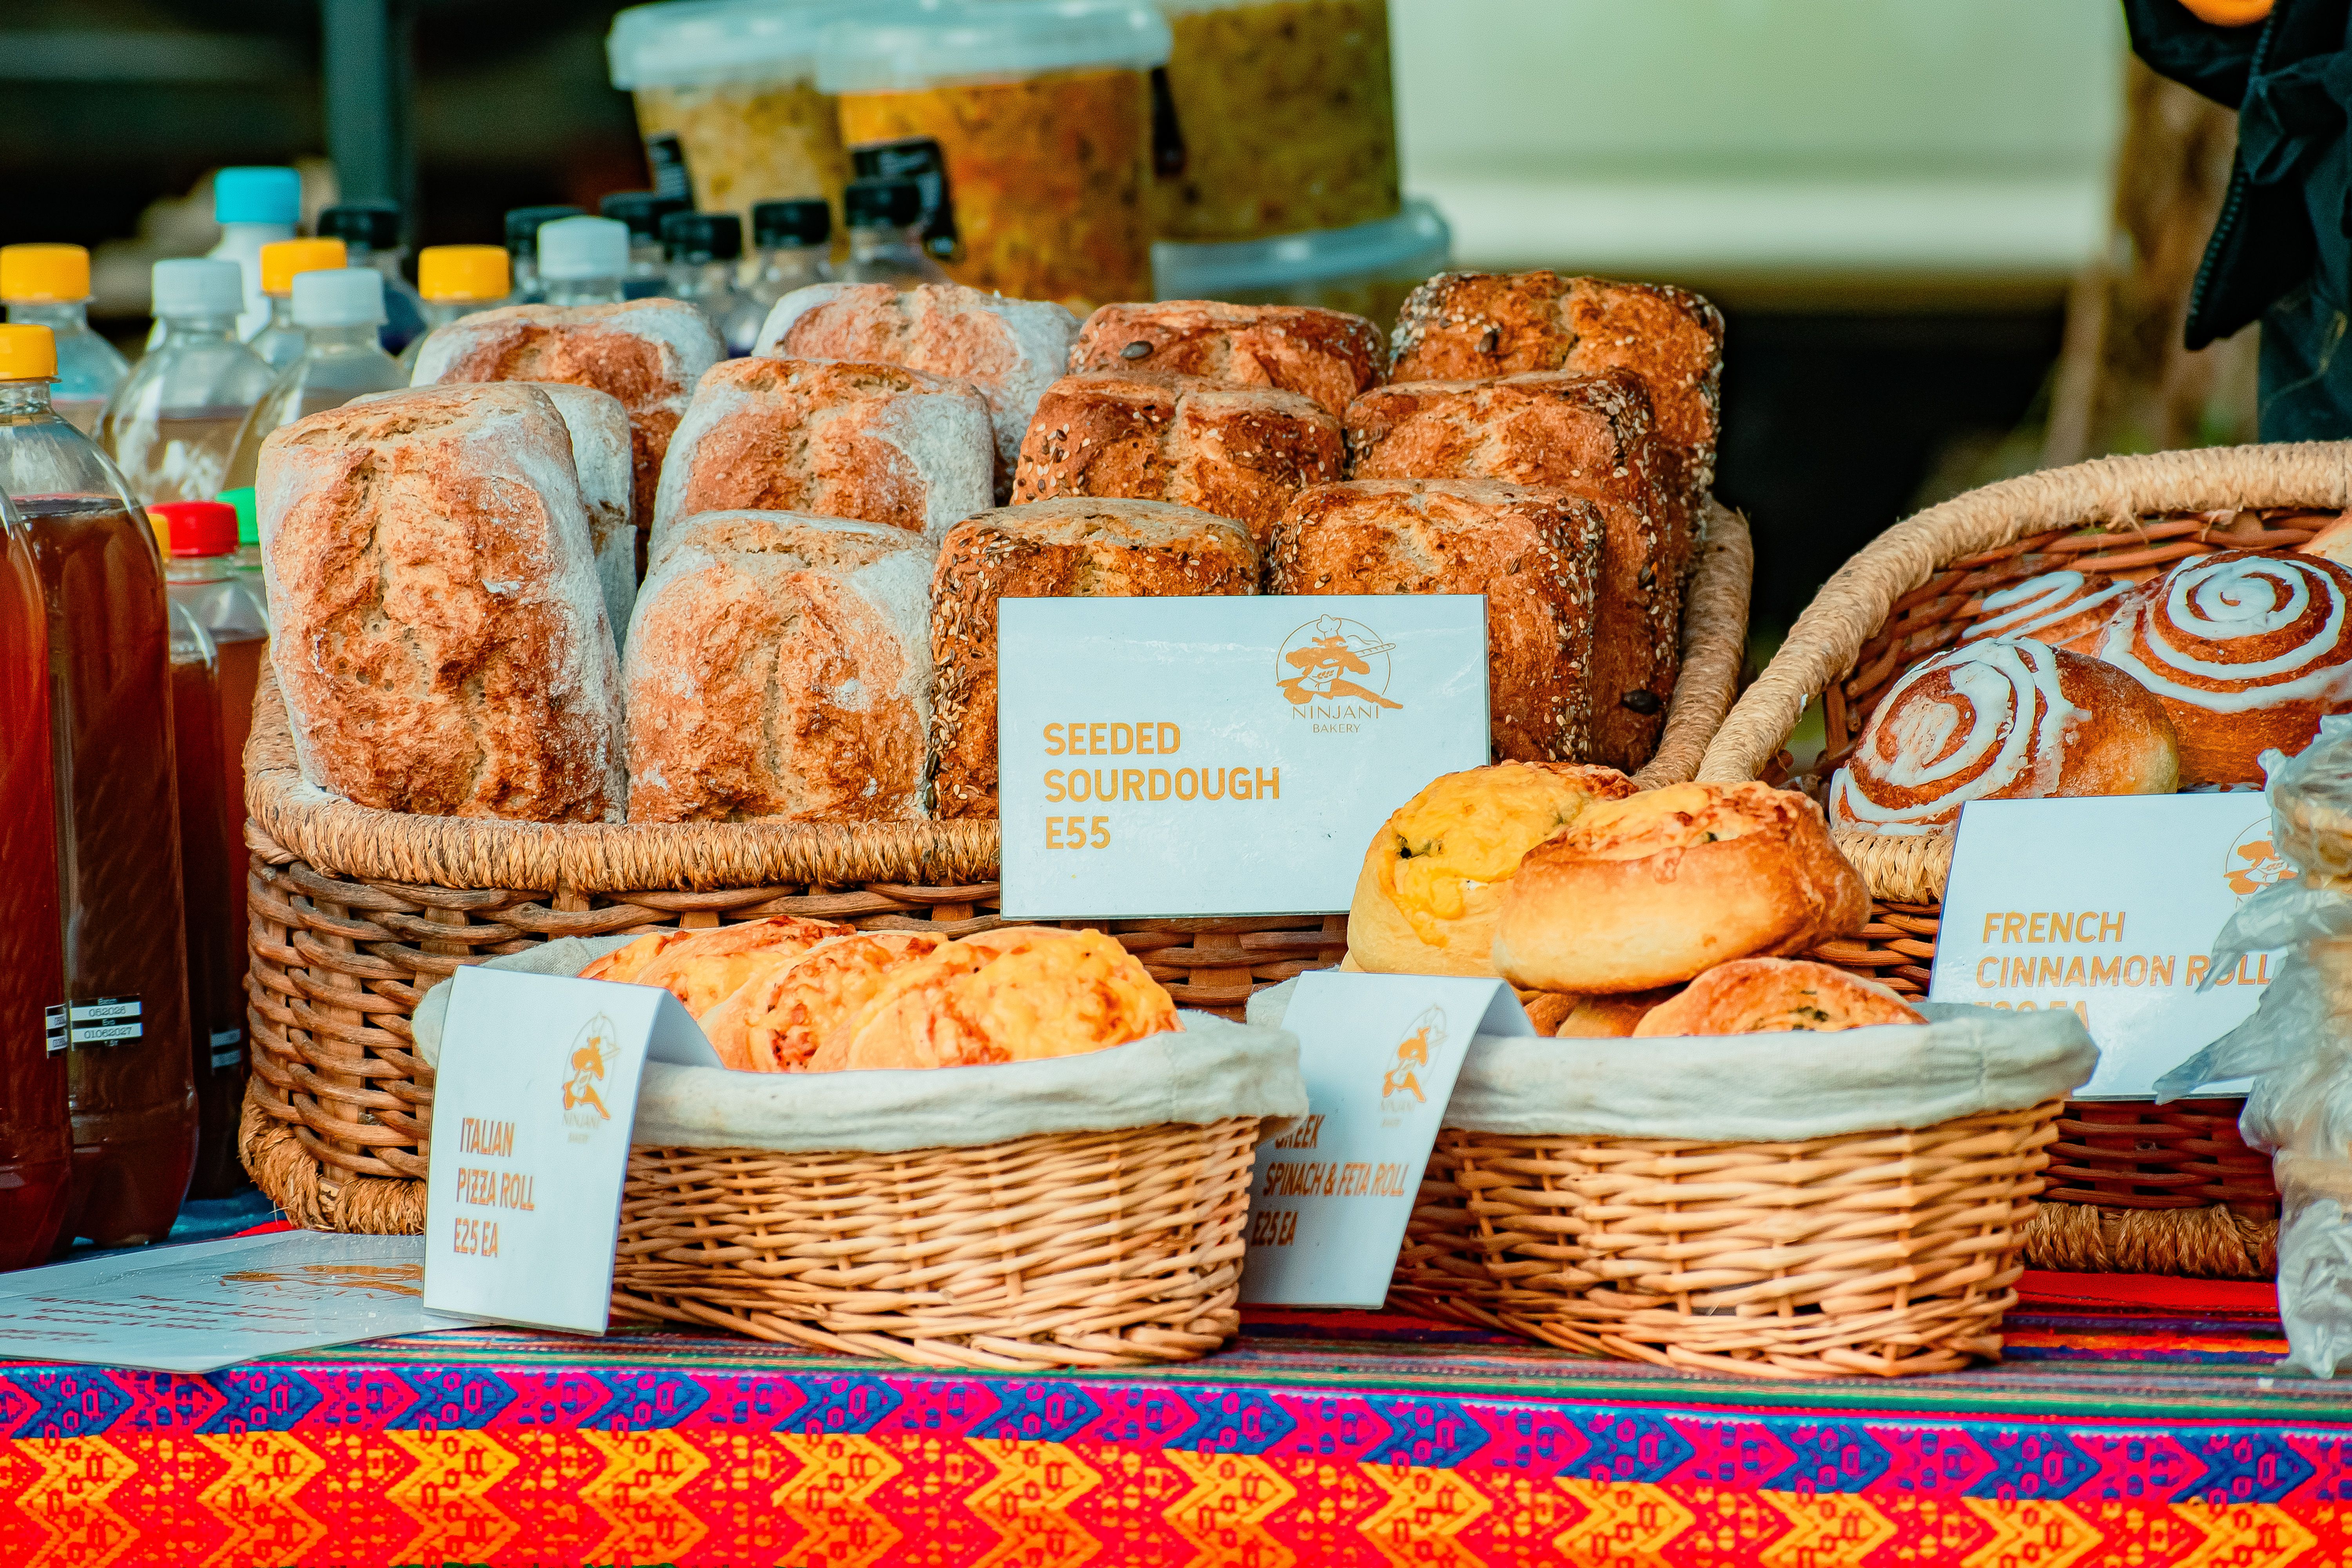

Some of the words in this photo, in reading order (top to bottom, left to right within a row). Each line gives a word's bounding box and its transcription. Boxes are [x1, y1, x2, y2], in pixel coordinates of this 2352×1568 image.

[1292, 705, 1379, 719] NINJANI
[1313, 723, 1361, 733] BAKERY
[1043, 722, 1181, 756] SEEDED
[1043, 766, 1280, 802] SOURDOUGH
[1045, 815, 1111, 849] E55
[1982, 911, 2125, 943] FRENCH
[1976, 955, 2175, 988] CINNAMON
[459, 1117, 515, 1157] ITALIAN
[456, 1167, 496, 1207] PIZZA
[499, 1172, 535, 1211] ROLL
[1262, 1162, 1326, 1196] SPINACH
[1323, 1162, 1337, 1196] &
[1336, 1162, 1372, 1196] FETA
[1370, 1163, 1410, 1196] ROLL
[454, 1217, 479, 1255] E25
[481, 1221, 498, 1258] EA
[1250, 1210, 1281, 1247] E25
[1277, 1210, 1299, 1247] EA
